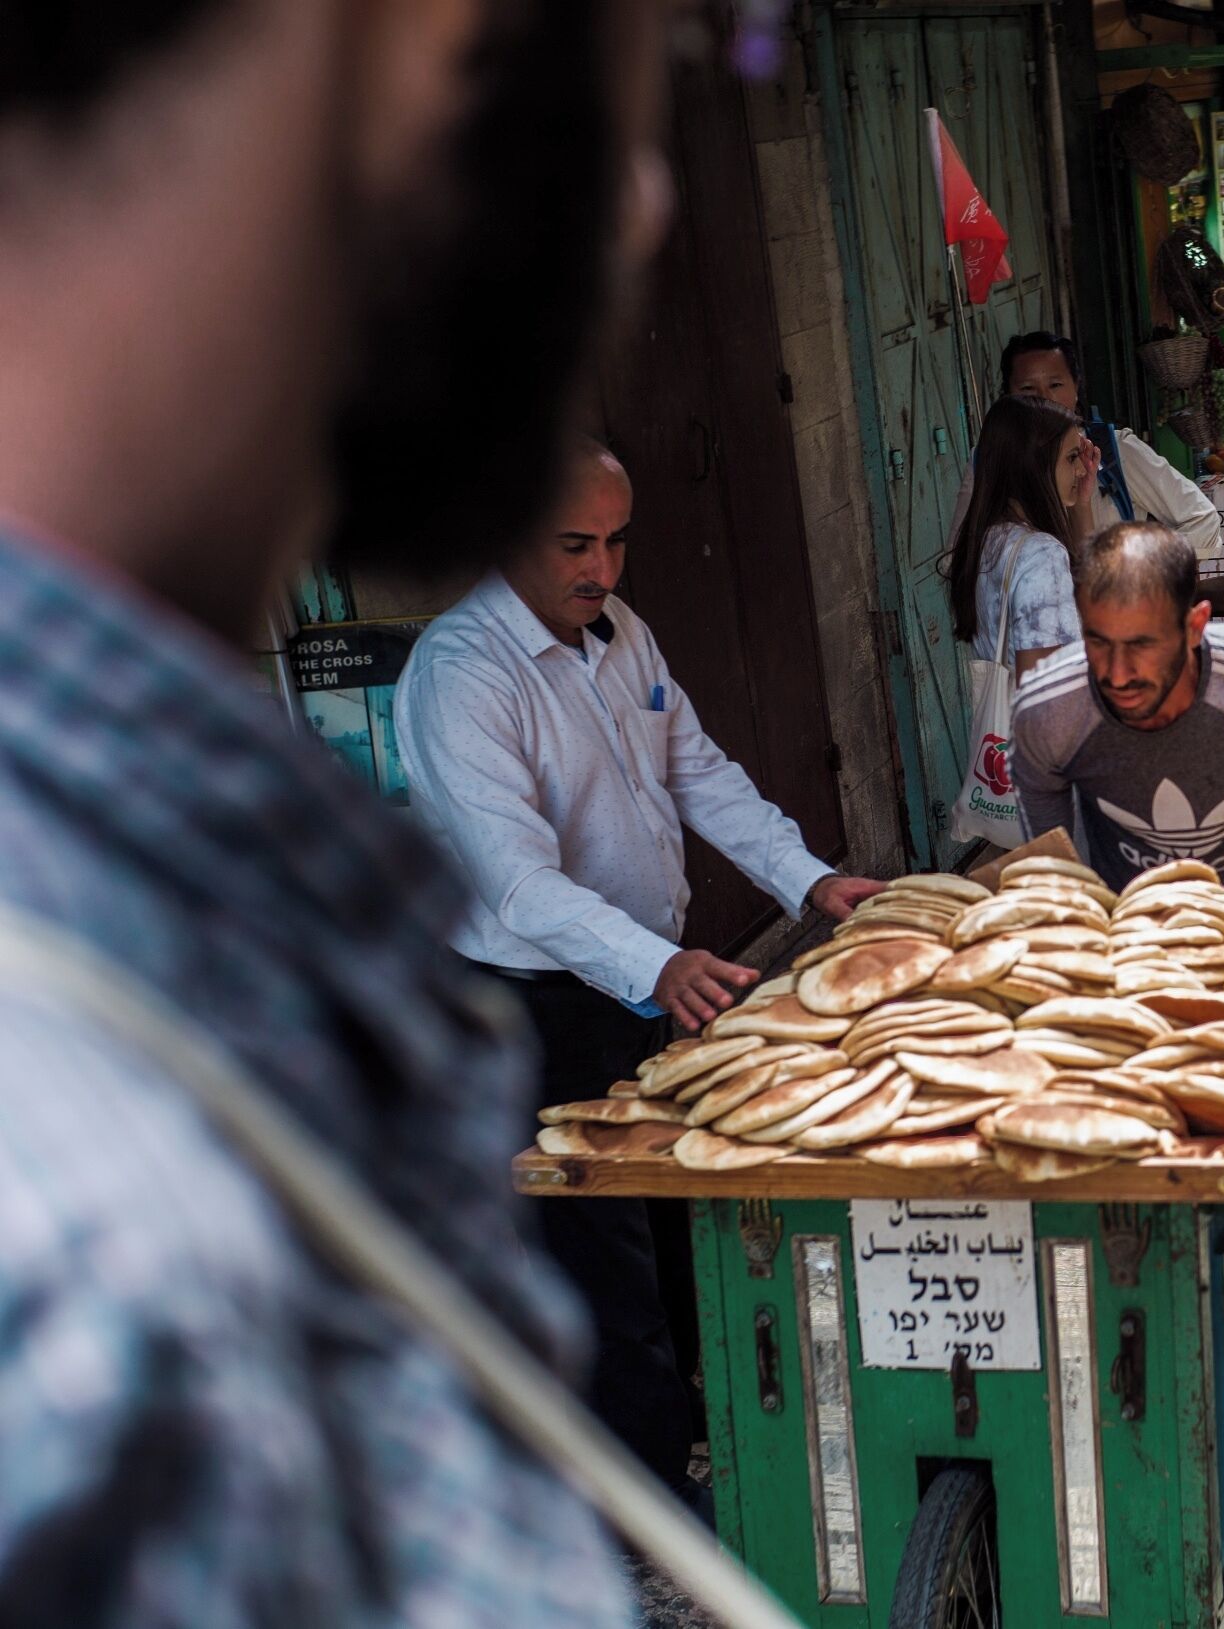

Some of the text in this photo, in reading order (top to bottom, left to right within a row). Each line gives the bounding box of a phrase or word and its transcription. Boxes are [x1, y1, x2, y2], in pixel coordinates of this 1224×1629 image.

[322, 654, 374, 669] CROSS
[966, 1233, 1024, 1263] باب
[908, 1267, 980, 1302] סבל
[888, 1310, 1005, 1333] שער יפו
[906, 1339, 919, 1360] 1
